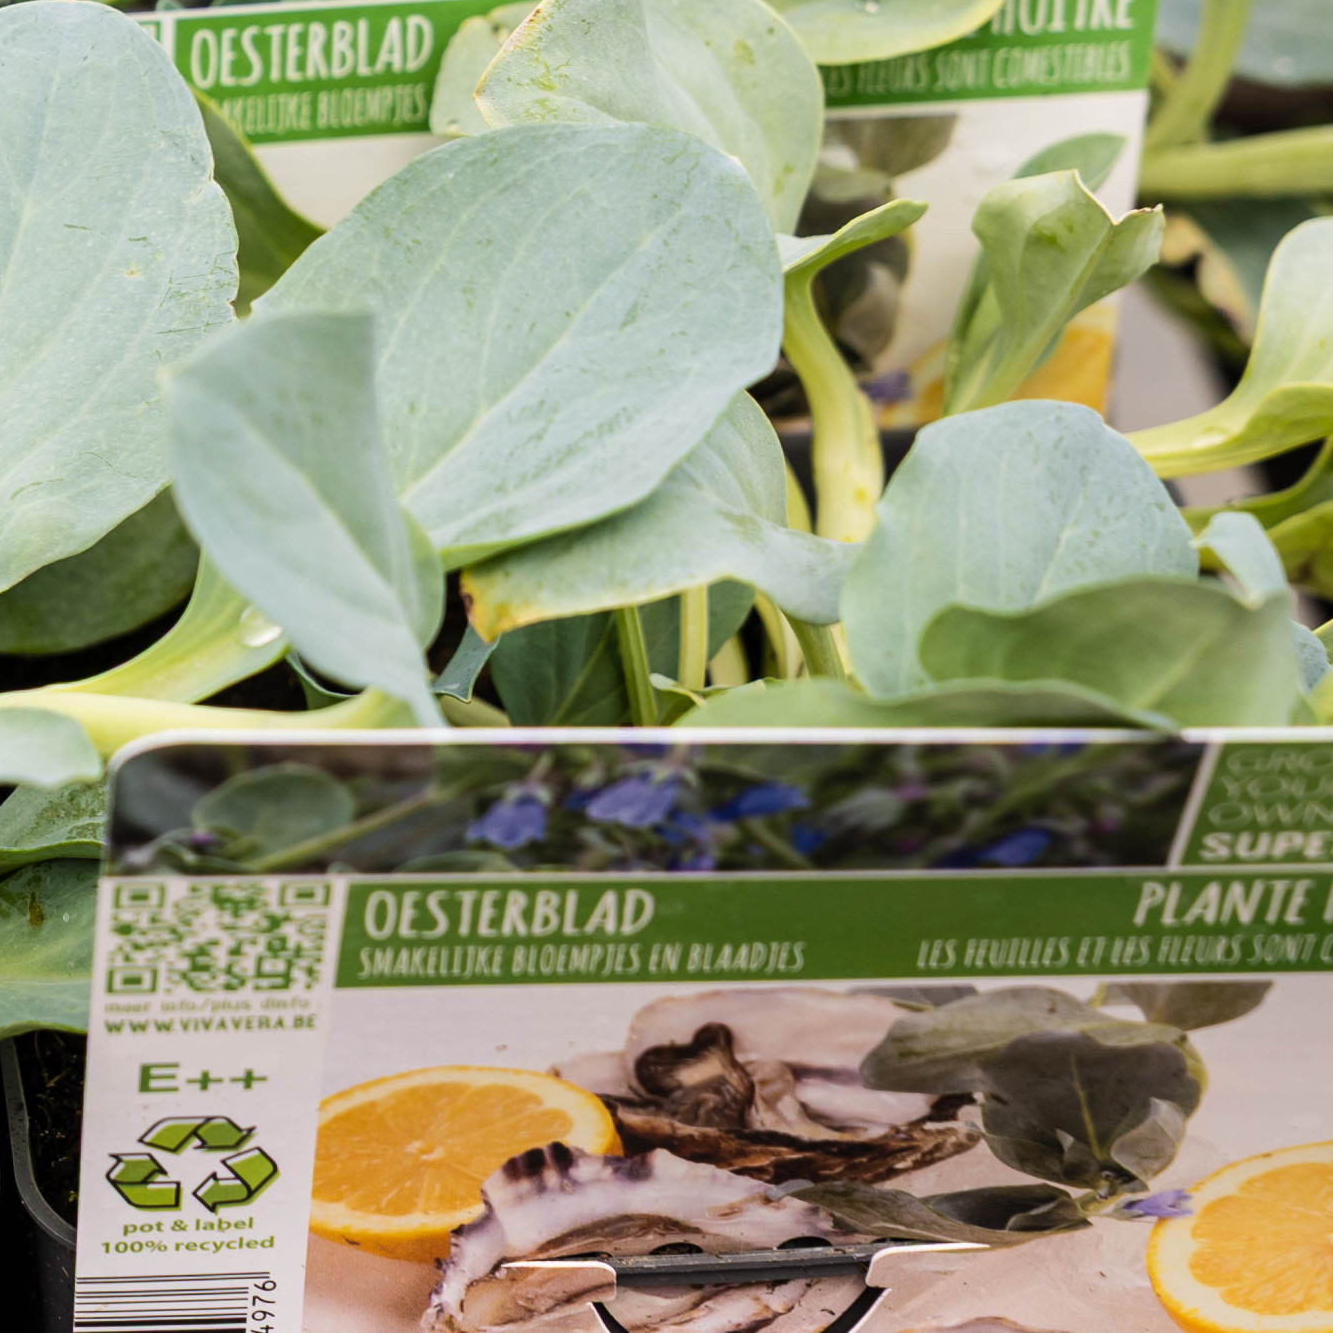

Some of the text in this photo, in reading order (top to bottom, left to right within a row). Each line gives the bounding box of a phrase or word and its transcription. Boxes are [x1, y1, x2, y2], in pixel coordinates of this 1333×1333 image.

[191, 13, 432, 90] OESTERBLAD
[934, 46, 990, 91] SONT
[993, 40, 1130, 89] COMESTIBLES
[317, 82, 427, 127] BLOEMPJES
[365, 889, 656, 940] OESTERBLAD
[1133, 879, 1316, 927] PLANTE
[357, 941, 806, 980] SMAKELIJKE BLOEMPJES EN BLAADJES
[917, 938, 958, 971] LES
[964, 936, 1071, 969] FEUILLES
[1077, 936, 1105, 967] ET
[1156, 934, 1242, 966] FLEURS
[1246, 933, 1318, 965] SONT
[138, 1063, 268, 1093] E++
[101, 1236, 276, 1254] 100% recycled
[122, 1217, 254, 1237] pot & label
